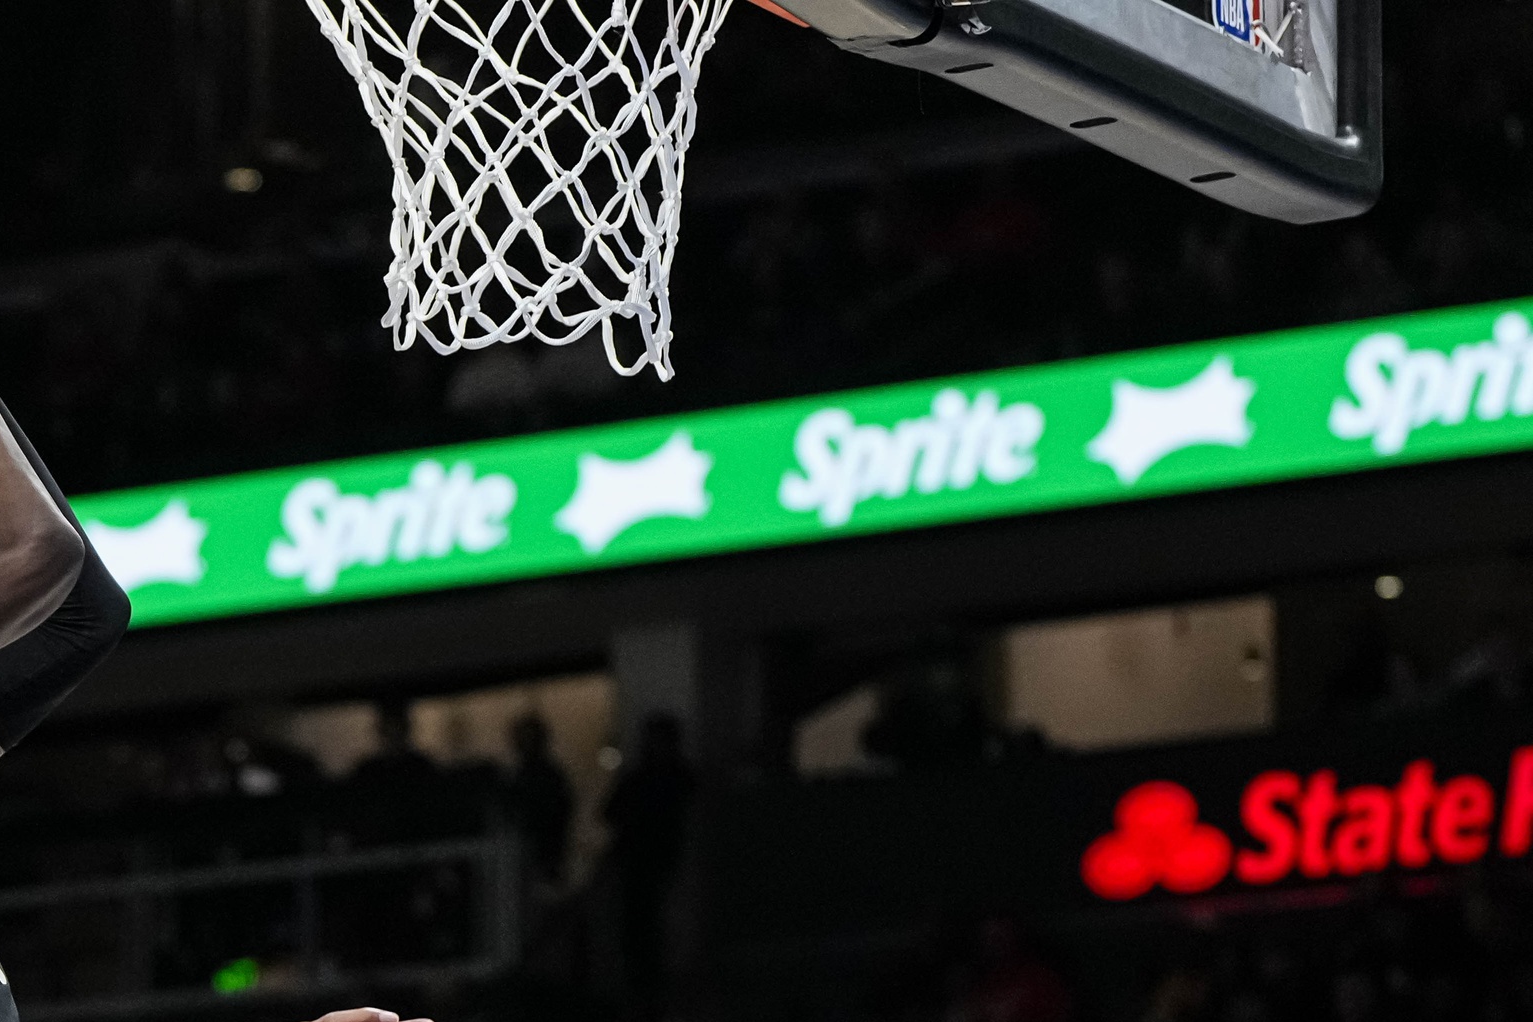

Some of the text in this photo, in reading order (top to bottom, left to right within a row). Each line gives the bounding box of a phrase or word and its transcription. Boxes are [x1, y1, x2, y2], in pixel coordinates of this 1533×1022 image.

[1221, 0, 1245, 33] NBA
[1328, 311, 1533, 456] Spri
[778, 387, 1046, 528] Sprite
[265, 459, 518, 594] Sprite
[1235, 761, 1494, 885] State
